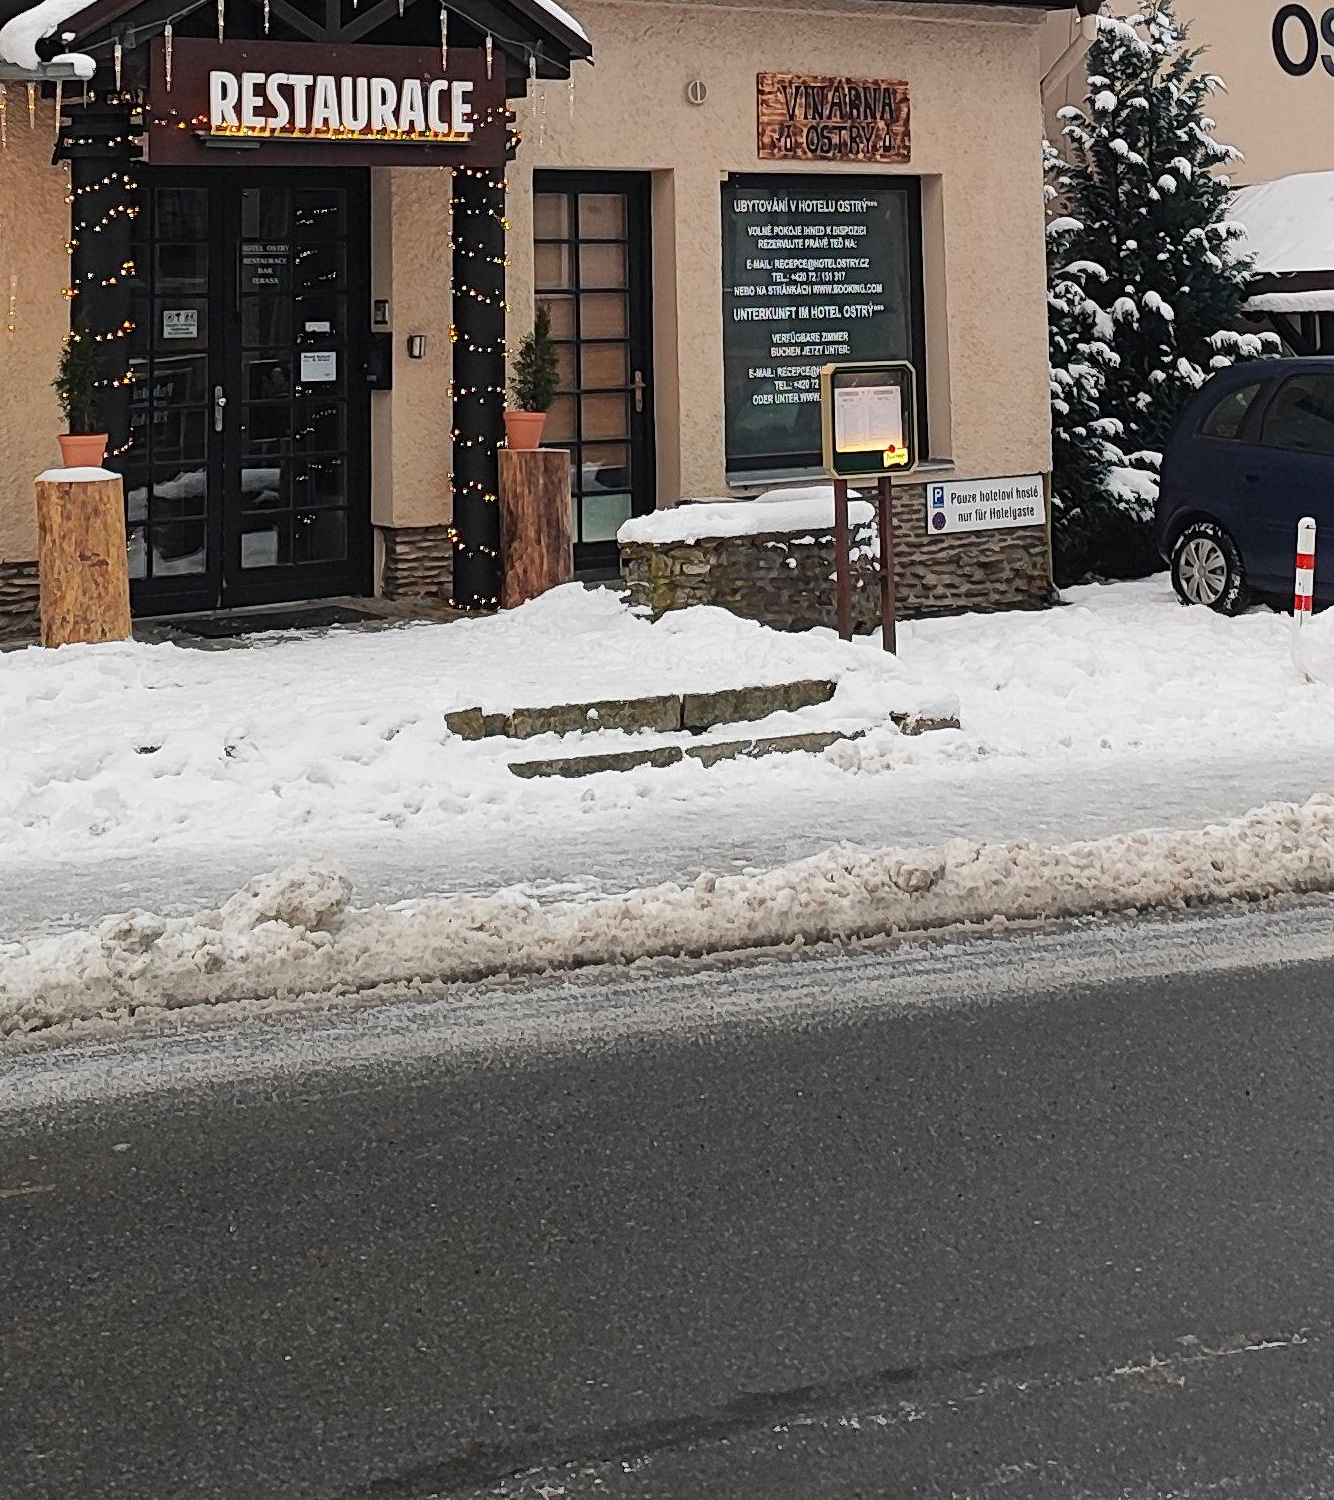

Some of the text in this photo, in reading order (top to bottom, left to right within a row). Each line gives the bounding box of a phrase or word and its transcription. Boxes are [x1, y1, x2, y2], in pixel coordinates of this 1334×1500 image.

[209, 70, 475, 134] RESTAURACE
[733, 197, 789, 213] UBYTOVÁNÍ
[790, 200, 798, 212] V
[799, 200, 836, 213] HOTELU
[774, 225, 802, 236] POKOJE
[734, 285, 755, 297] NEBO
[733, 307, 797, 322] UNTERKUNFT
[798, 306, 809, 319] IM
[811, 304, 842, 319] HOTEL
[770, 346, 801, 357] BUCHEN
[752, 393, 774, 405] ODER
[951, 492, 977, 506] Pouze
[958, 511, 973, 522] nur
